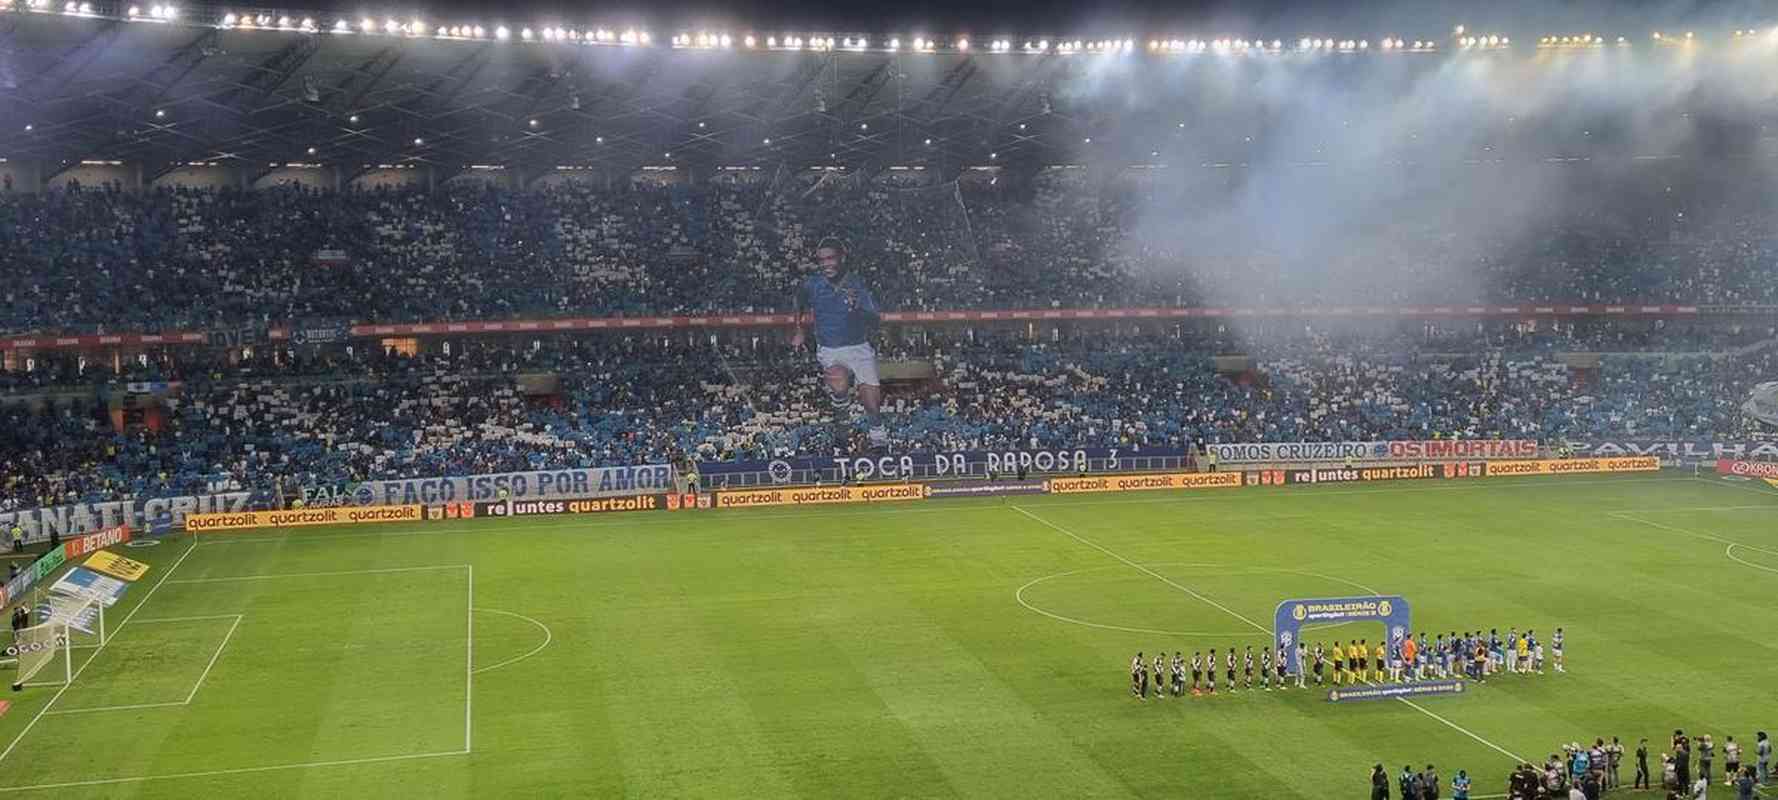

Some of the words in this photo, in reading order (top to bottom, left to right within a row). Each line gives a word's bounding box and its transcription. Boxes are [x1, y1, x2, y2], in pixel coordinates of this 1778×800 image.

[1277, 442, 1369, 460] CRUZEIRO
[1390, 440, 1421, 457] OS
[1424, 440, 1537, 457] IMORTAIS
[833, 456, 914, 478] TOCA
[935, 453, 967, 475] DA
[987, 450, 1088, 473] RAPOSA
[1108, 448, 1119, 468] 3
[1362, 464, 1434, 481] quartzolit
[1490, 461, 1541, 474] quartzolit
[1549, 459, 1600, 473] quartzolit
[1608, 457, 1659, 471] quartzolit
[468, 474, 527, 500] ISSO
[538, 470, 588, 495] POR
[599, 466, 672, 492] AMOR
[1053, 477, 1110, 493] quartzolit
[1118, 475, 1174, 490] quartzolit
[1182, 471, 1238, 487] quartzolit
[570, 494, 656, 514] quartzolit
[722, 491, 783, 507] quartzolit
[792, 489, 851, 504] quartzolit
[862, 486, 920, 501] quartzolit
[189, 511, 258, 530] quartzolit
[270, 508, 337, 527] quartzolit
[349, 505, 416, 523] quartzolit
[83, 527, 122, 553] BETANO
